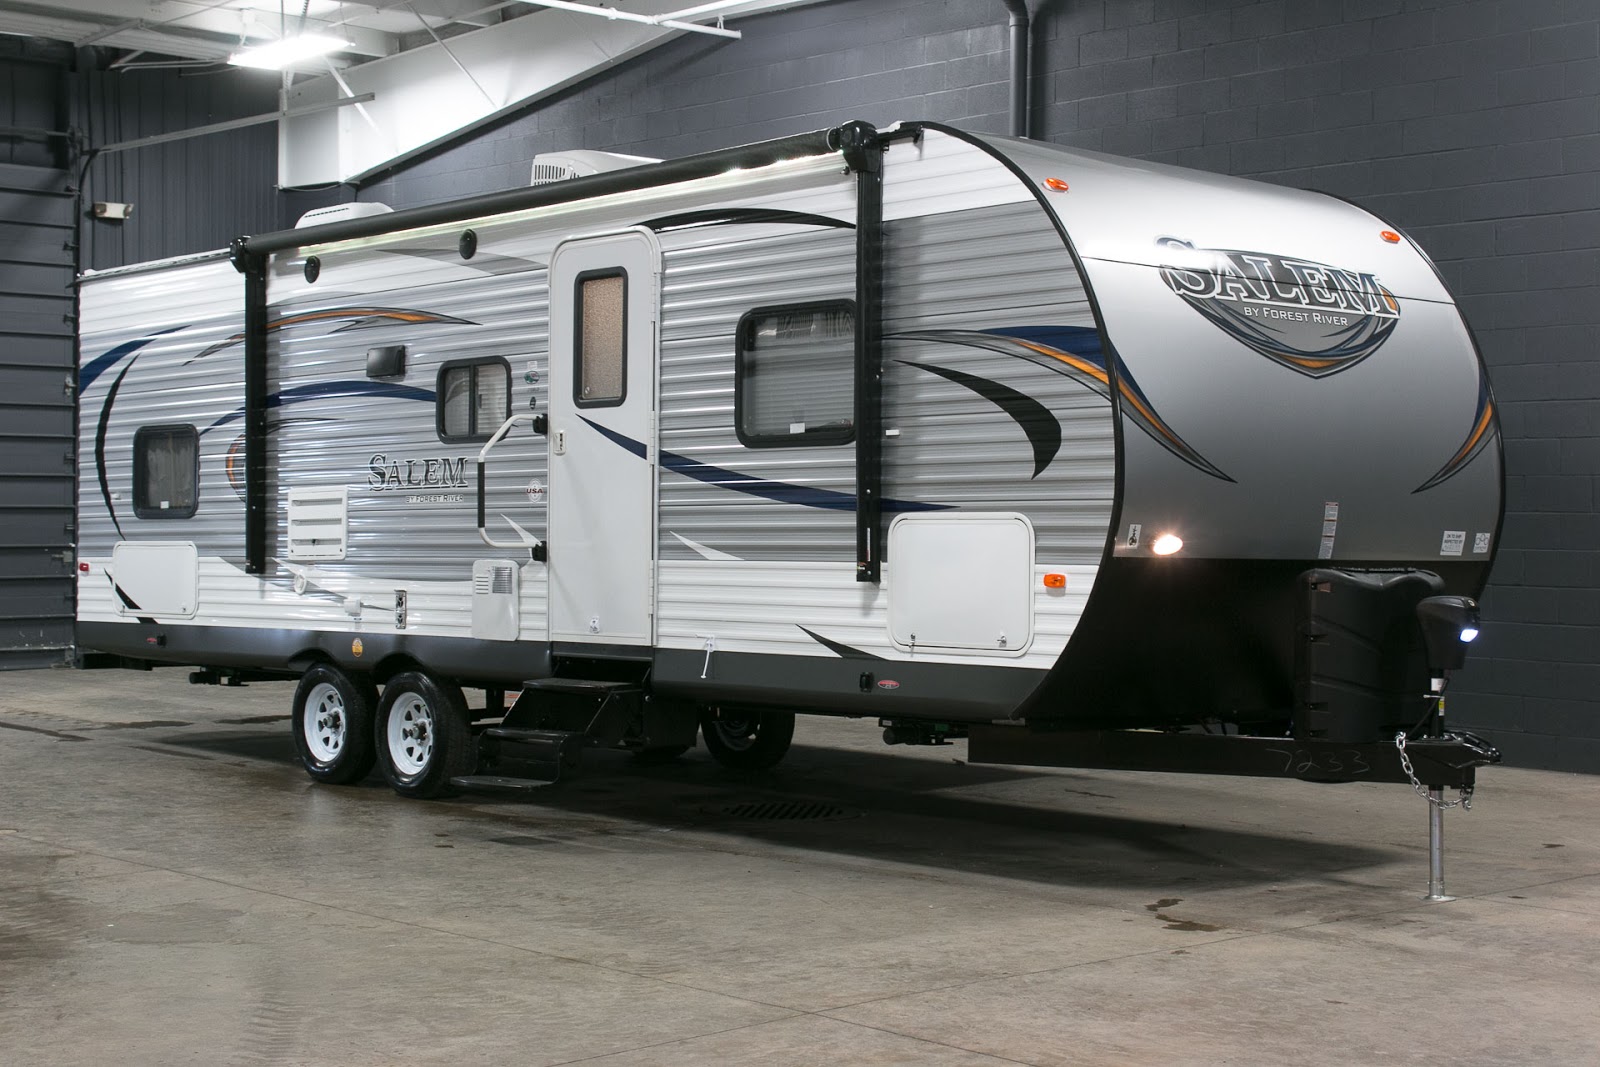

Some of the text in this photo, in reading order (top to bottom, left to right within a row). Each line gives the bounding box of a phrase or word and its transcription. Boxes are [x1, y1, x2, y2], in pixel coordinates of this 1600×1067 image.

[1156, 235, 1401, 320] SALEM
[1243, 306, 1349, 327] BY FOREST RIVER
[368, 453, 469, 491] SALEM
[416, 495, 442, 503] FOREST
[443, 494, 464, 502] RIVER
[1265, 748, 1370, 774] 7233
